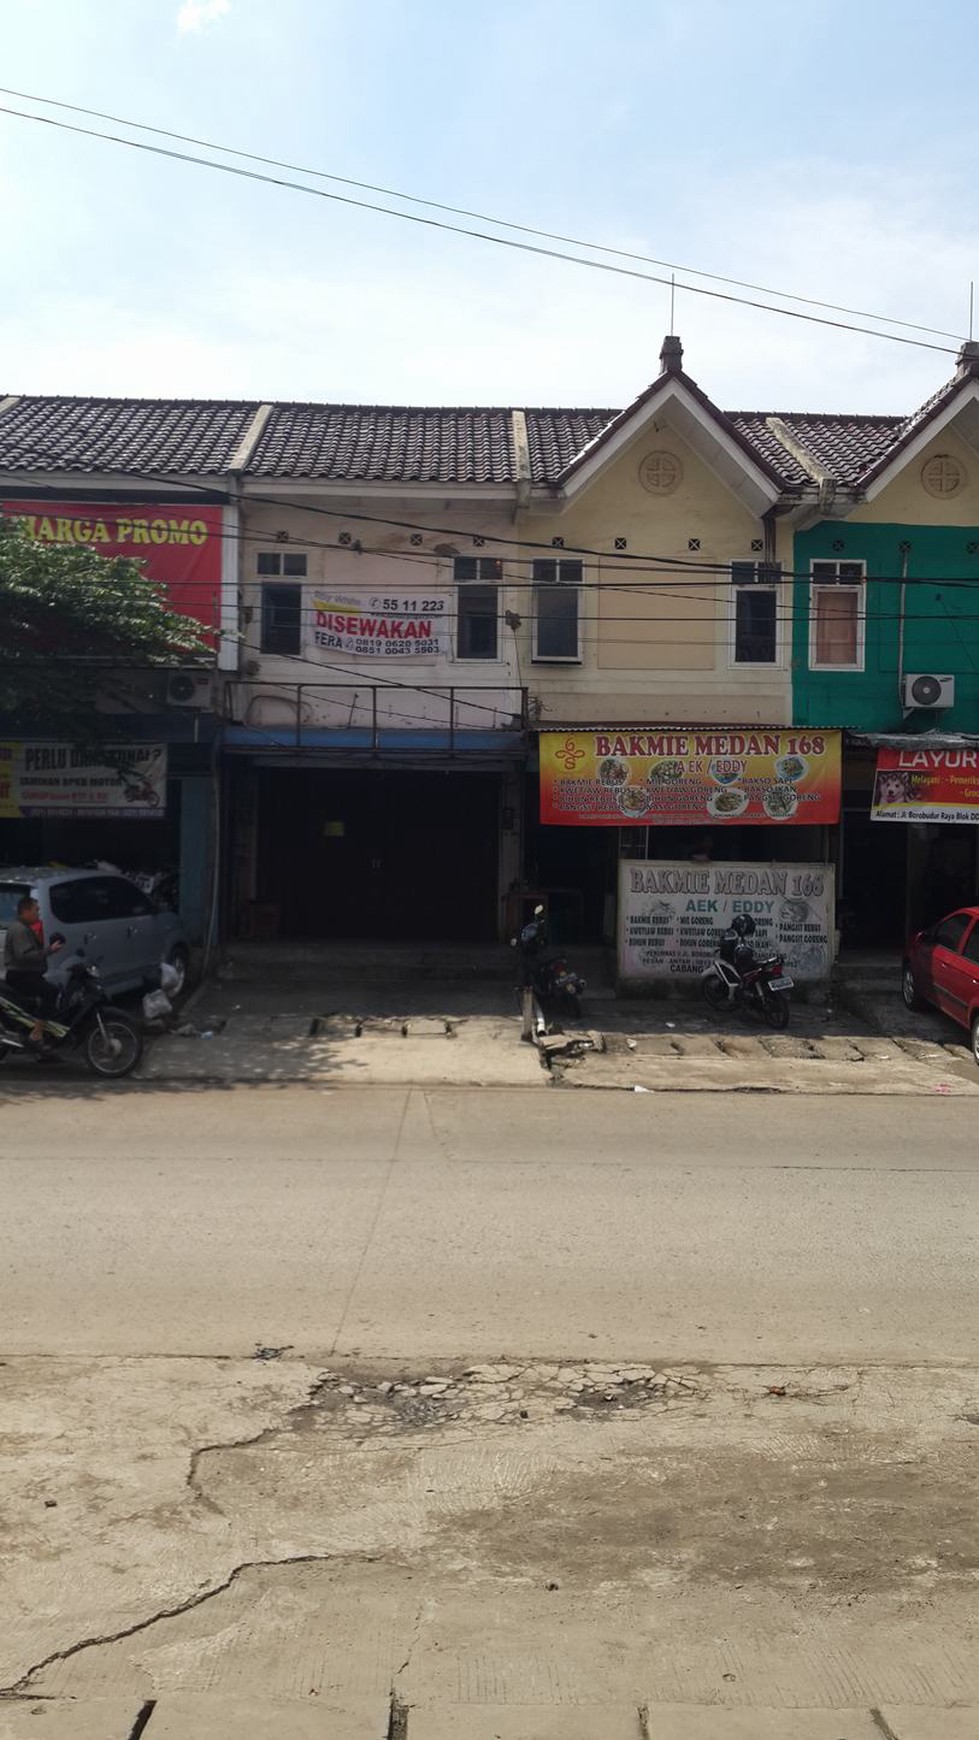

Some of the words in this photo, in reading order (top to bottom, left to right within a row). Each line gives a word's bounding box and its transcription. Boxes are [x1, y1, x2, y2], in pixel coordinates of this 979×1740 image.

[117, 519, 208, 545] PROMO
[383, 599, 398, 610] 55
[403, 601, 417, 611] 11
[422, 601, 444, 612] 223
[316, 611, 432, 638] DISEWAKAN
[315, 631, 342, 648] FERA
[356, 638, 382, 647] 0819
[595, 735, 689, 757] BAKMIE
[694, 735, 781, 756] MEDAN
[788, 735, 825, 756] 168
[26, 748, 67, 771] PERLU
[716, 761, 748, 772] EDDY
[909, 811, 940, 820] Borobudur
[631, 869, 711, 894] BAKMIE
[714, 870, 788, 896] MEDAN
[792, 874, 825, 897] 168
[685, 900, 718, 912] AEK
[732, 901, 775, 913] EDDY
[629, 916, 650, 925] BAKMIE
[691, 917, 714, 925] GORENG
[780, 923, 803, 932] PANGSIT
[780, 935, 803, 943] PANGSIT
[804, 935, 828, 944] GORENG
[670, 964, 704, 974] CABANG
